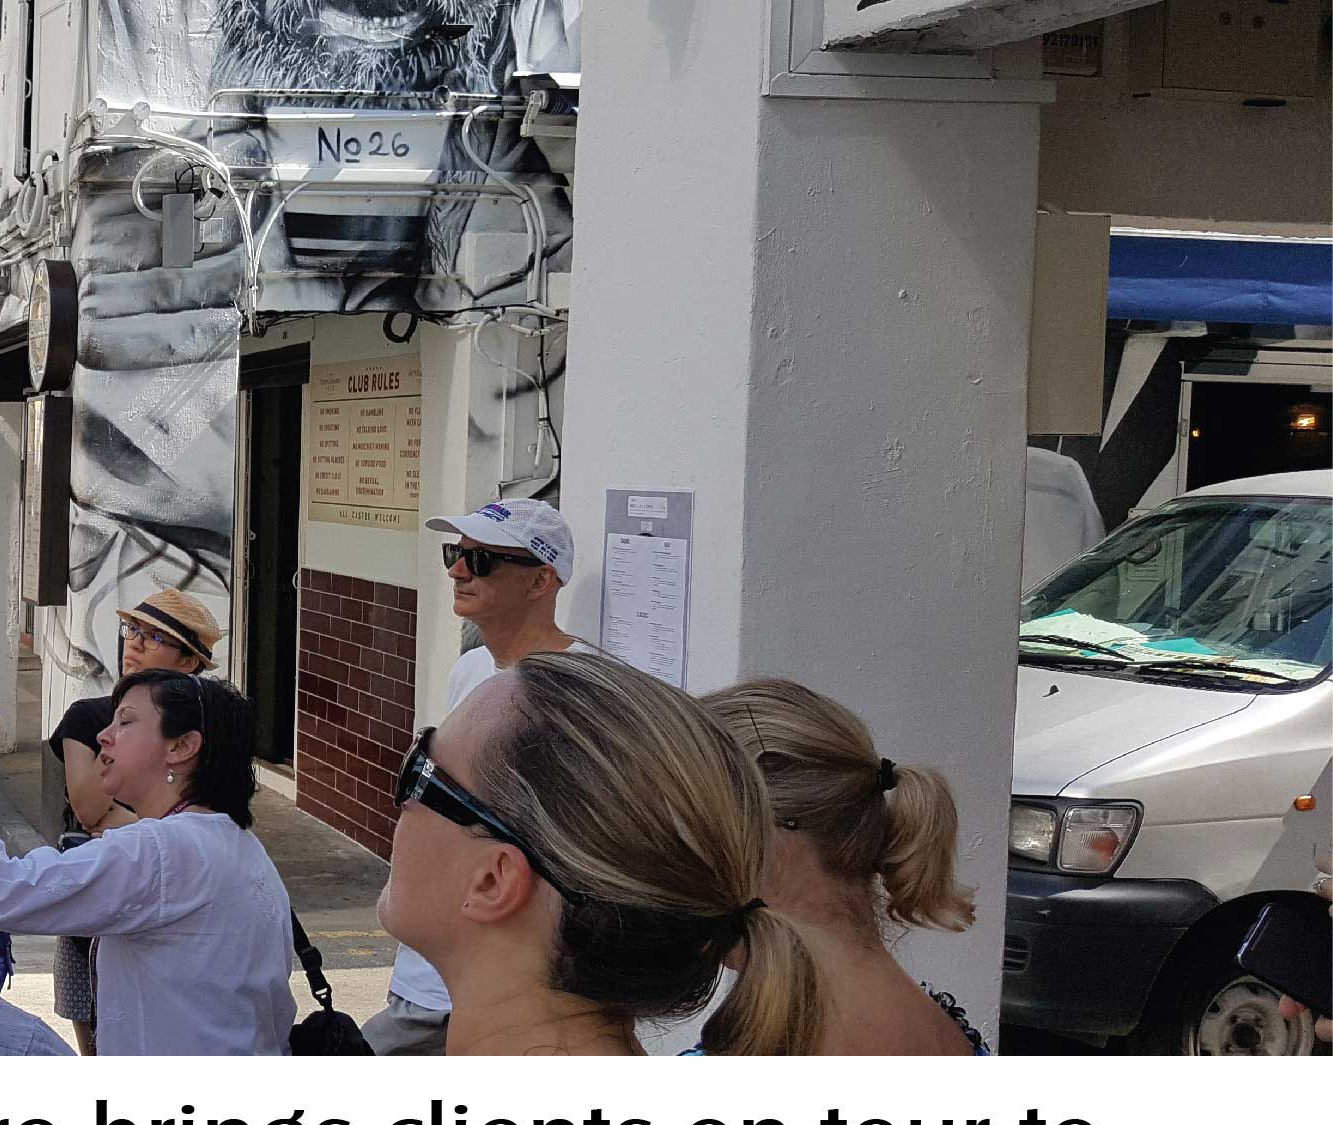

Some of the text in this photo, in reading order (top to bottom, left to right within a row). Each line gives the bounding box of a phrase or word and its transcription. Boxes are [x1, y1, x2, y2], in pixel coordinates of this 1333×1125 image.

[369, 131, 410, 157] 26
[348, 375, 369, 393] CLUB
[372, 372, 399, 391] RULES
